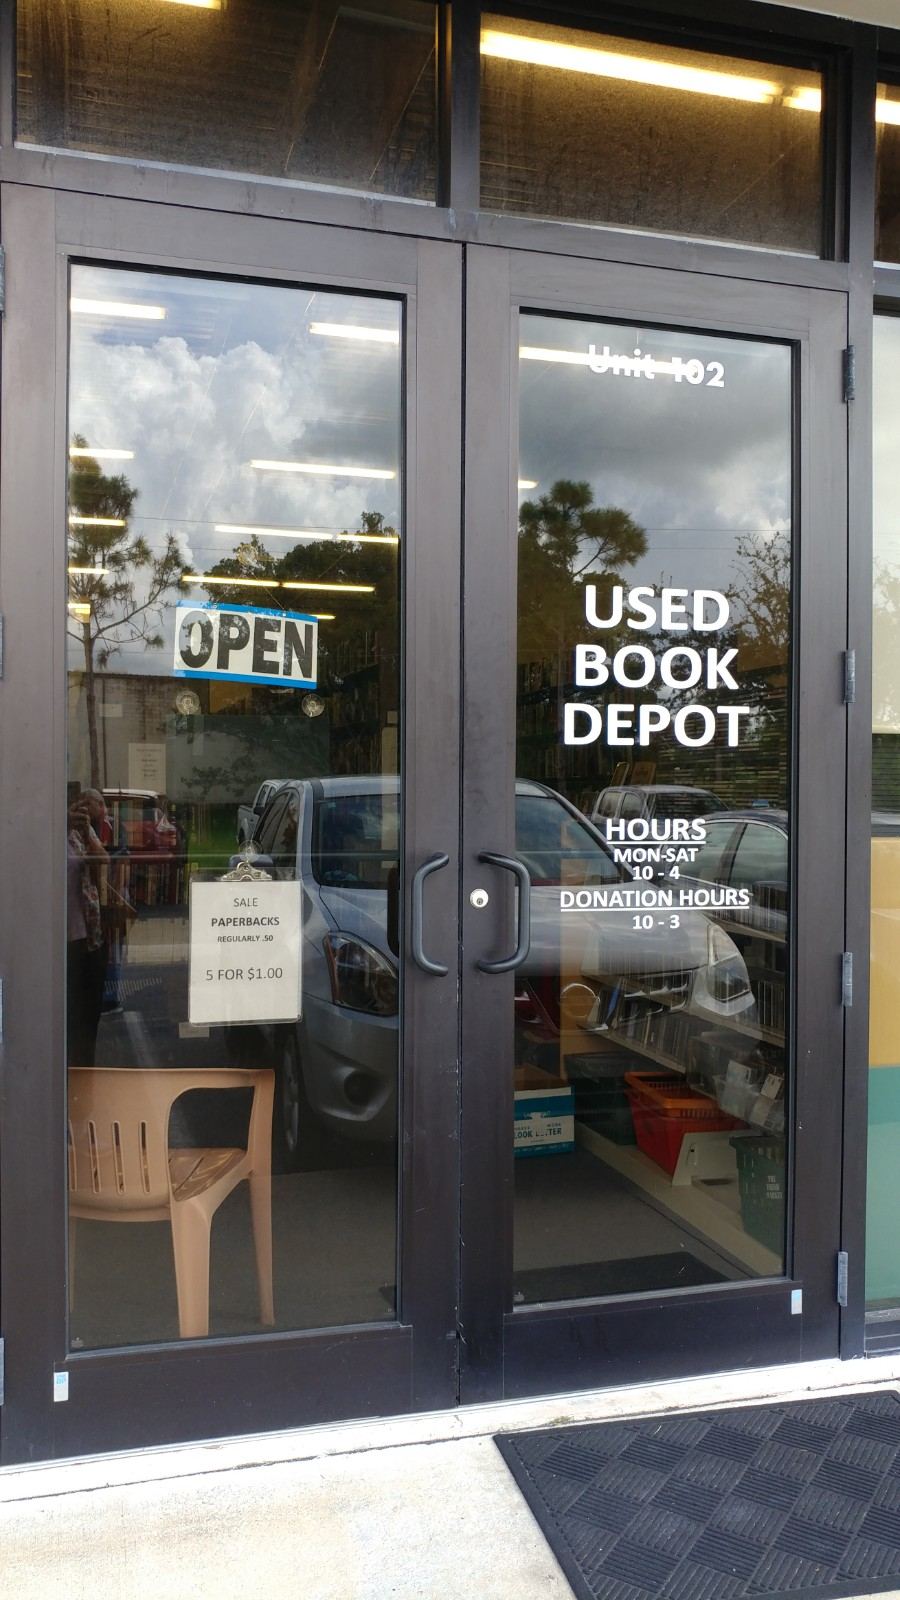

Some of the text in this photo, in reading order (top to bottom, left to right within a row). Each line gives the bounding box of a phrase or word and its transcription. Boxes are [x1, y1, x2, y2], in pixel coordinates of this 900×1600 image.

[588, 344, 725, 388] Unit 102
[585, 584, 730, 631] USED
[178, 610, 313, 679] OPEN
[575, 643, 739, 690] BOOK
[563, 702, 750, 747] DEPOT
[606, 817, 707, 842] HOURS
[613, 847, 699, 863] MON-SAT
[632, 865, 653, 881] 10
[669, 865, 681, 880] 4
[233, 897, 259, 908] SALE
[560, 888, 750, 908] DONATION HOURS
[211, 916, 280, 927] PAPERBACKS
[632, 915, 653, 930] 10
[669, 915, 680, 929] 3
[217, 934, 274, 943] REGULARLY .50
[205, 967, 283, 981] 5 FOR $1.00
